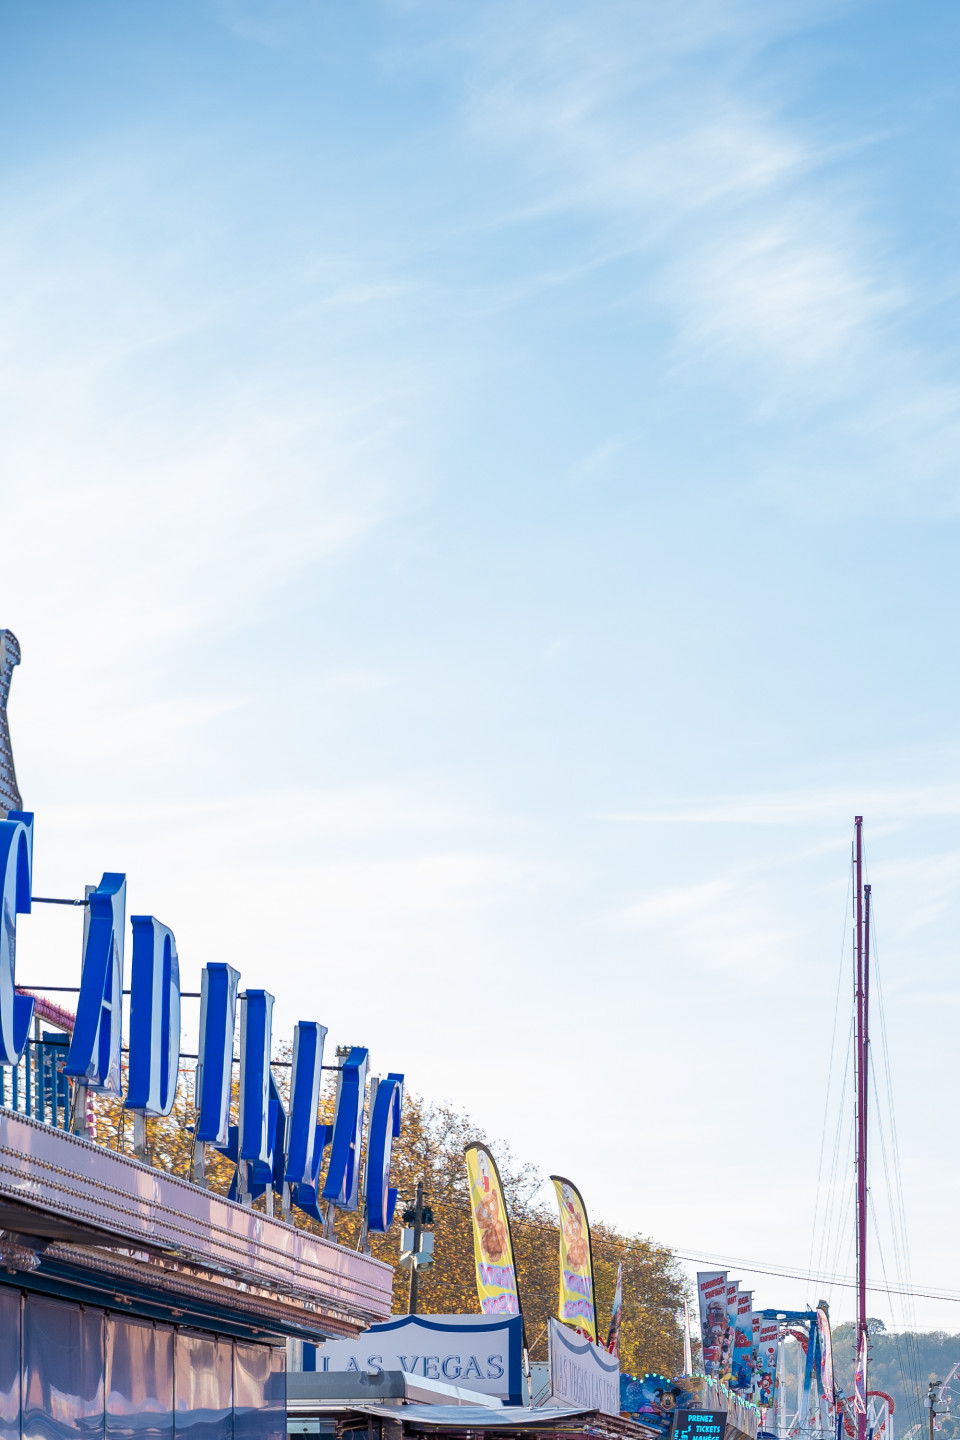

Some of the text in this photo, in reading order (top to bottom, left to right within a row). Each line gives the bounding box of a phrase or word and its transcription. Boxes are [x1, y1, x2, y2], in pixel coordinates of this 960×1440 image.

[704, 1286, 726, 1300] ENFANT
[397, 1354, 505, 1380] VEGAS
[687, 1414, 714, 1423] PRENEZ
[695, 1425, 721, 1433] TICKETS
